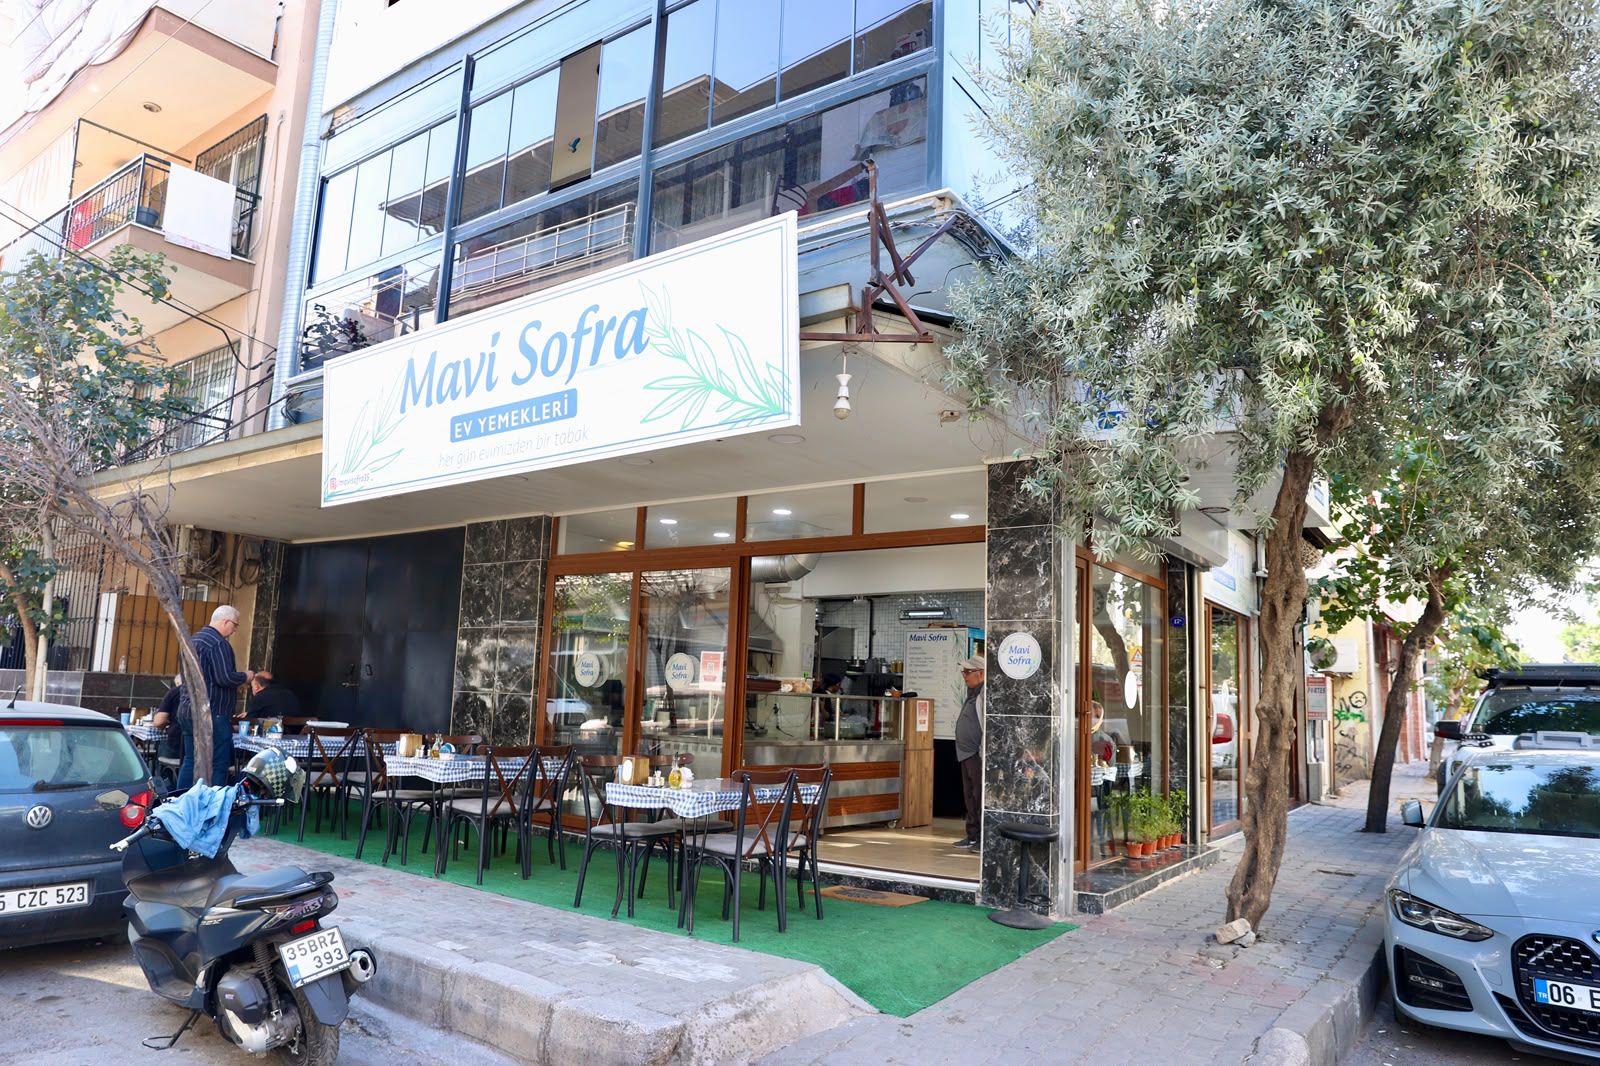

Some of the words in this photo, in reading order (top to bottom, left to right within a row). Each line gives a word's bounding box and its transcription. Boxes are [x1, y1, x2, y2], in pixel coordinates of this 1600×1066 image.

[400, 331, 500, 414] Mavi
[511, 304, 650, 386] Sofra
[453, 419, 479, 439] EV
[478, 394, 569, 434] YEMEKLERİ
[439, 451, 454, 468] her
[536, 428, 553, 451] bir
[554, 424, 590, 446] tabak
[909, 633, 927, 642] Mavi
[928, 633, 947, 642] Sofra
[1008, 645, 1031, 654] Mavi
[580, 660, 594, 669] Mavi
[672, 662, 687, 671] Mavi
[1008, 655, 1032, 666] Sofra
[579, 668, 594, 678] Sofra
[671, 671, 688, 680] Sofra
[17, 890, 48, 909] CZC
[56, 886, 85, 904] 523
[286, 931, 339, 961] 35BRZ
[313, 948, 344, 969] 393
[1537, 991, 1548, 999] TR
[1549, 983, 1576, 1005] 06
